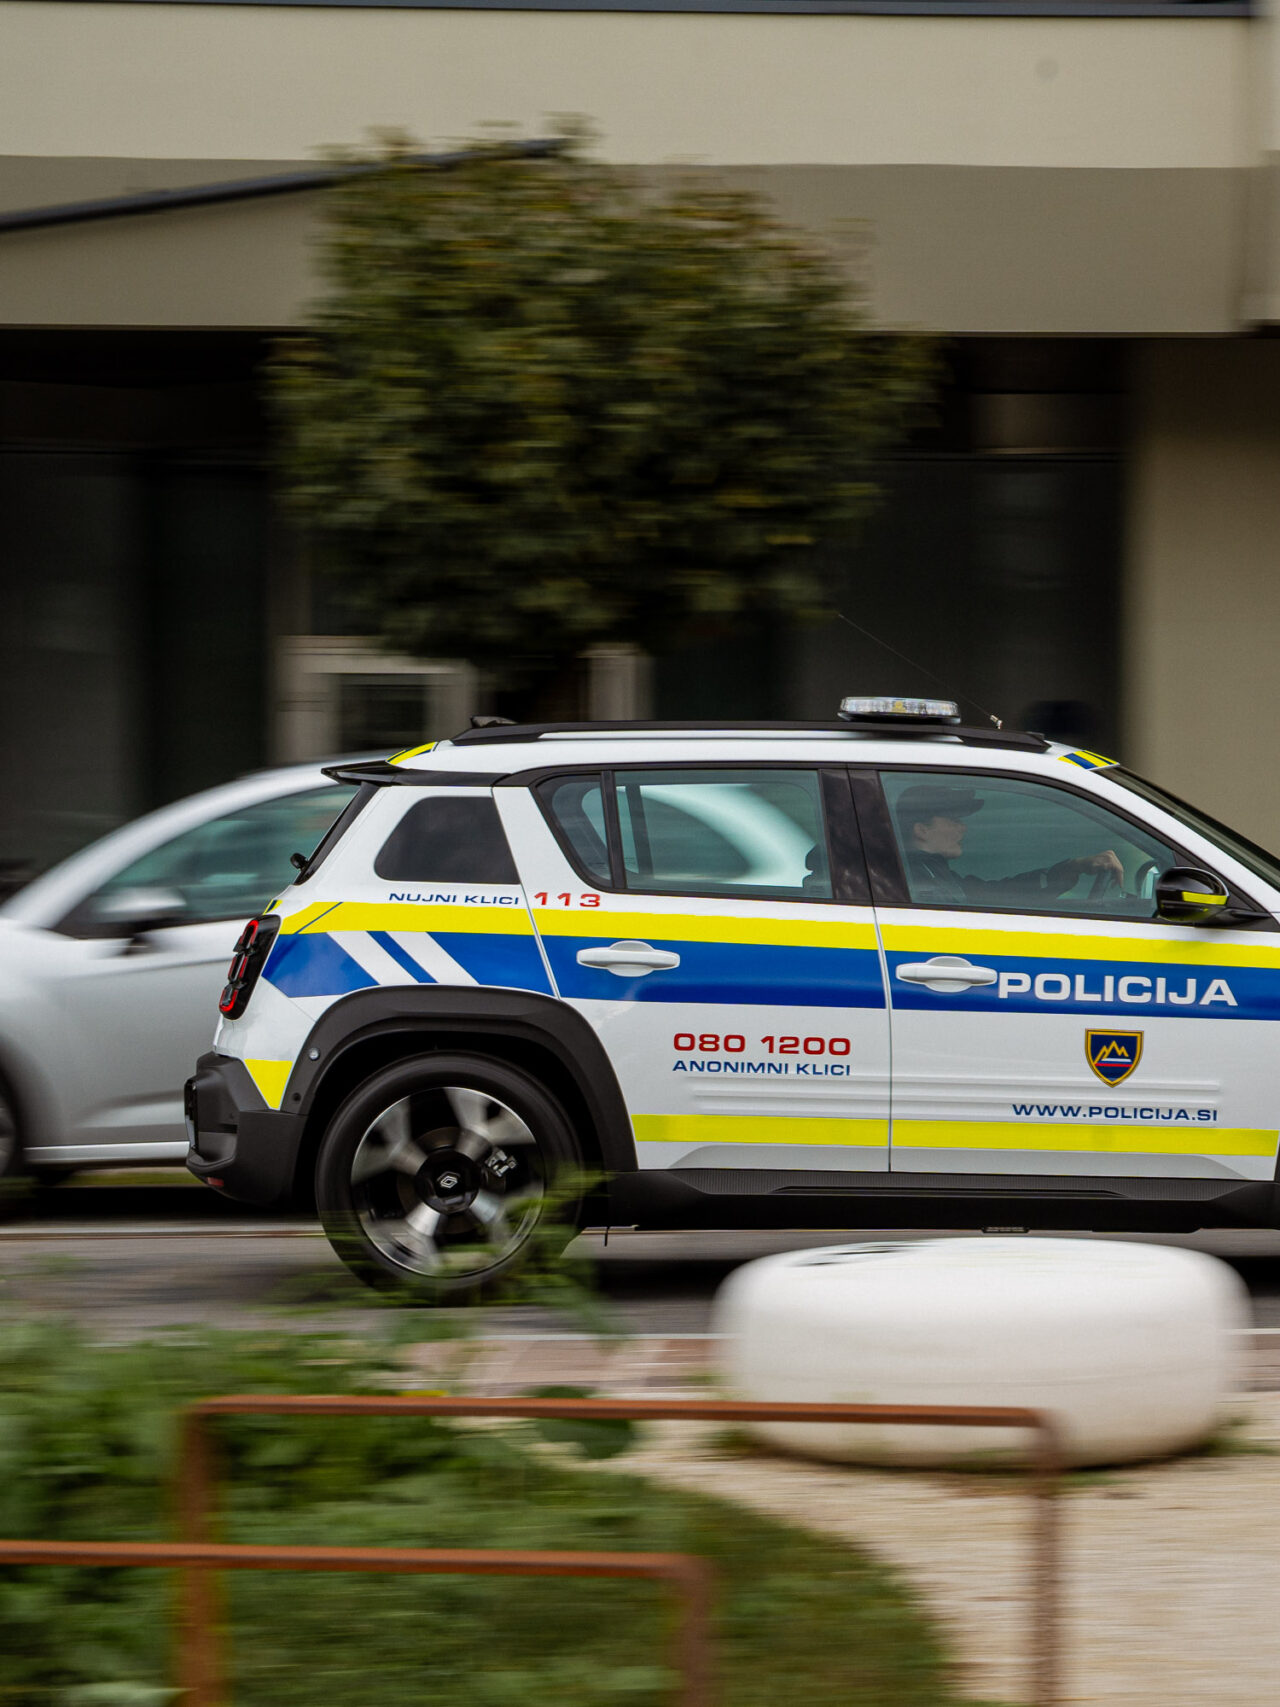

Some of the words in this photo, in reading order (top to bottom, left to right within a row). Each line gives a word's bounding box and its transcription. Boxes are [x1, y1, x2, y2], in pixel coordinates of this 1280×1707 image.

[388, 892, 457, 903] NUJNI
[464, 895, 519, 905] KLICI
[533, 892, 601, 908] 113
[998, 972, 1238, 1007] POLICIJA
[673, 1033, 746, 1053] 080
[761, 1036, 851, 1056] 1200
[672, 1060, 788, 1075] ANONIMNI
[797, 1063, 850, 1076] KLICI
[1012, 1104, 1218, 1122] WWW.POLICIJA.SI
